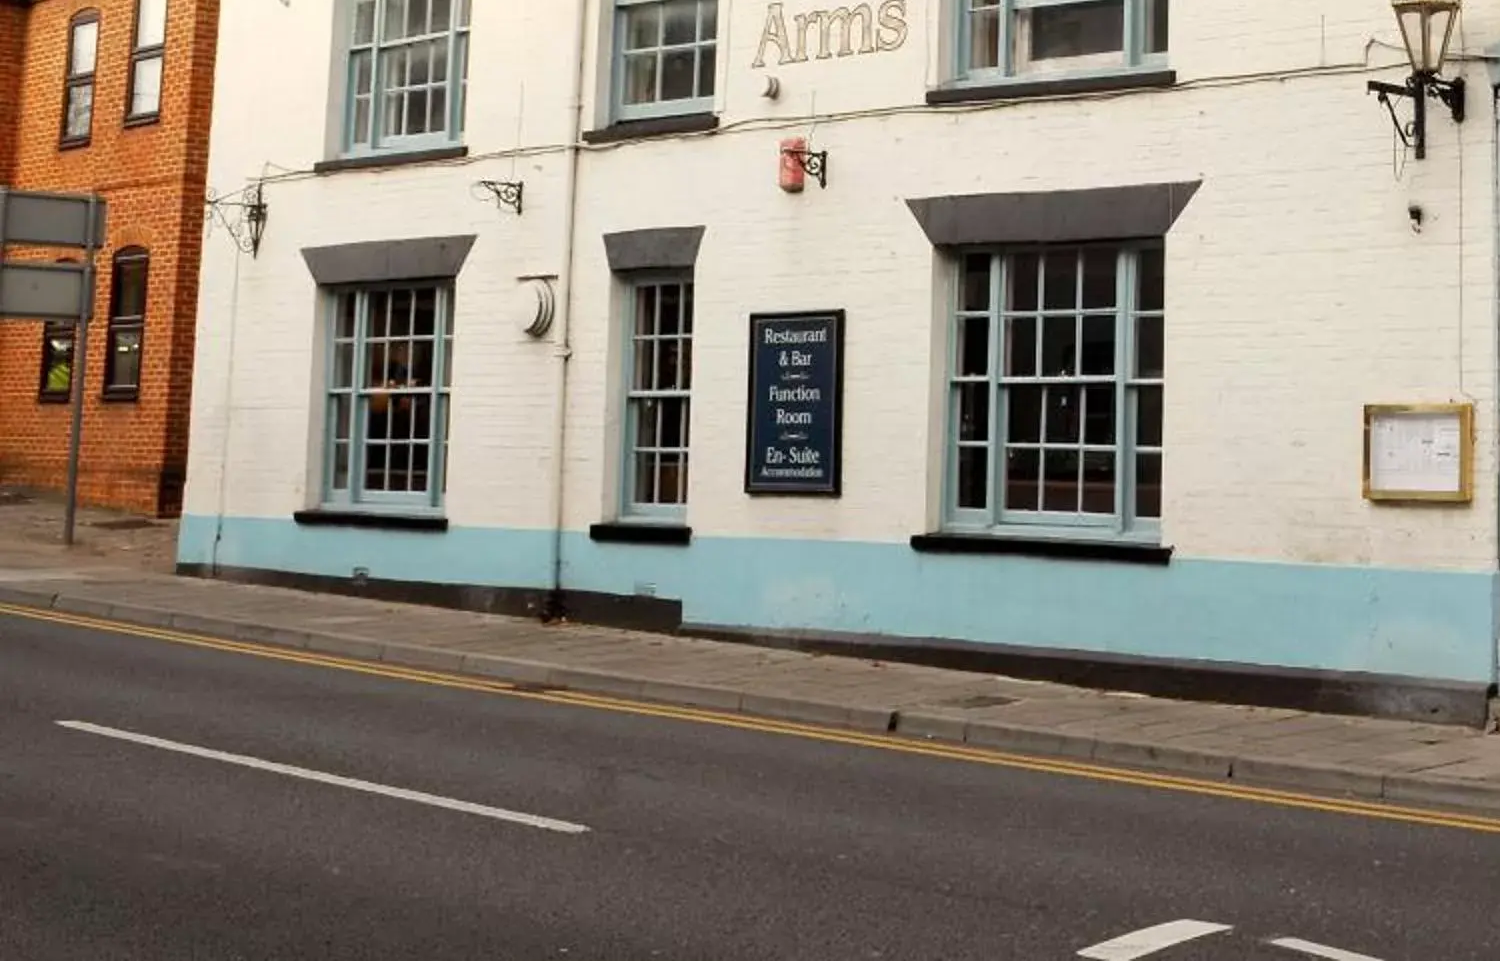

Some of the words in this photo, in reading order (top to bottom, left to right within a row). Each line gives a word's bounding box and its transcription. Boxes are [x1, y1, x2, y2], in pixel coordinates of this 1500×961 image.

[764, 328, 827, 344] Restaurant
[779, 351, 788, 366] &
[791, 350, 813, 366] Bar
[769, 384, 820, 402] Function
[776, 409, 812, 424] Room
[766, 447, 787, 464] En-
[789, 446, 820, 464] Suite
[760, 467, 823, 478] Accommodation
